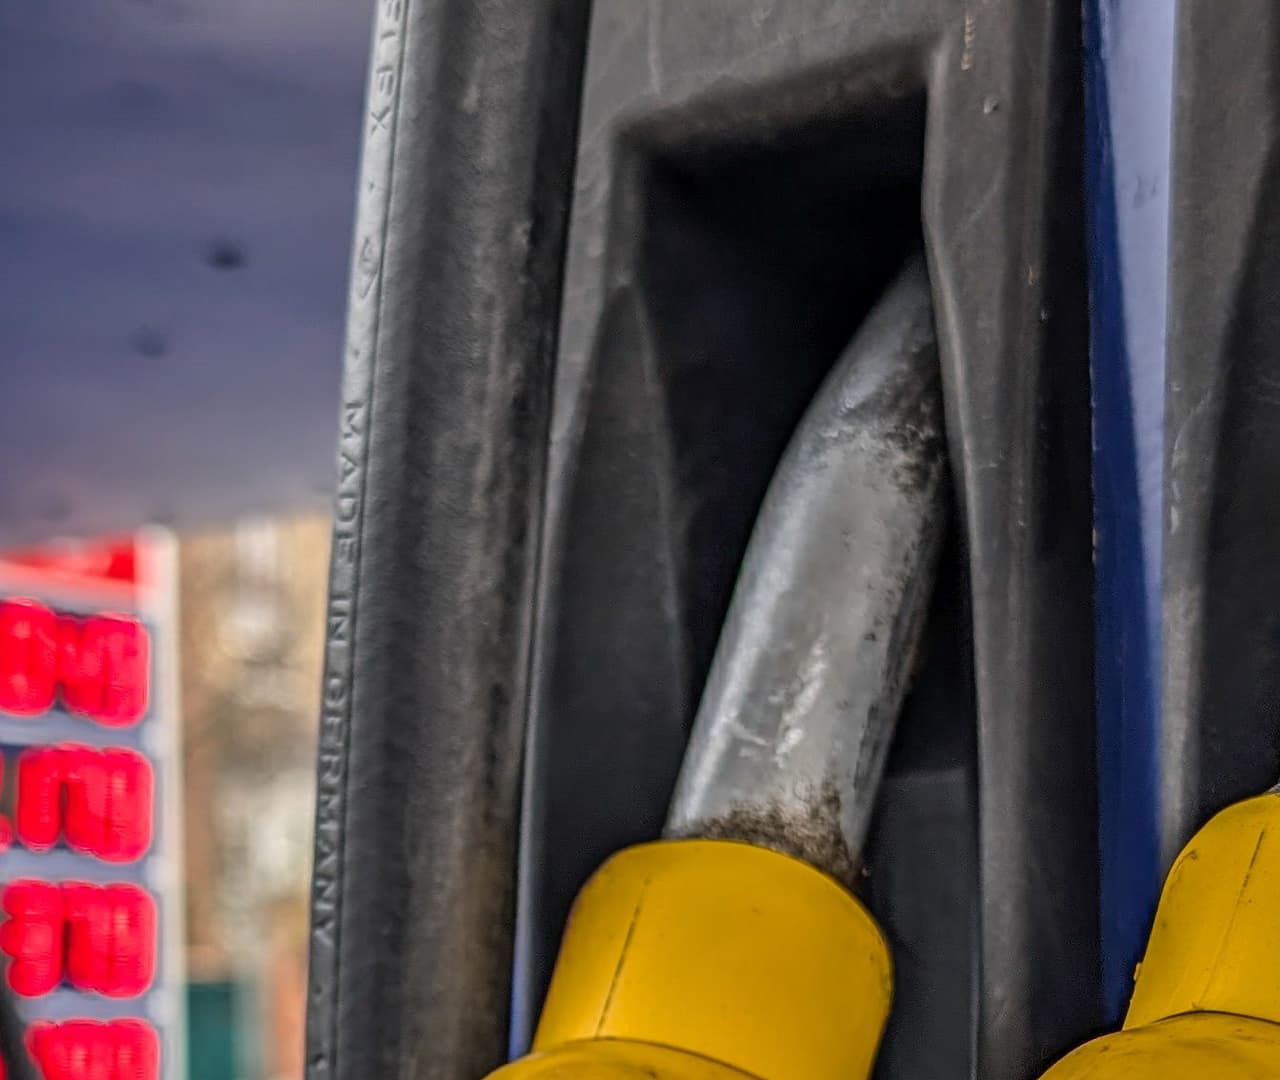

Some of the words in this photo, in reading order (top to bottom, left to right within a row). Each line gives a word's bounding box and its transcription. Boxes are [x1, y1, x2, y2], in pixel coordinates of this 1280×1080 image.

[332, 401, 366, 563] MADE
[326, 594, 353, 651] IN
[313, 676, 348, 949] GERMANY
